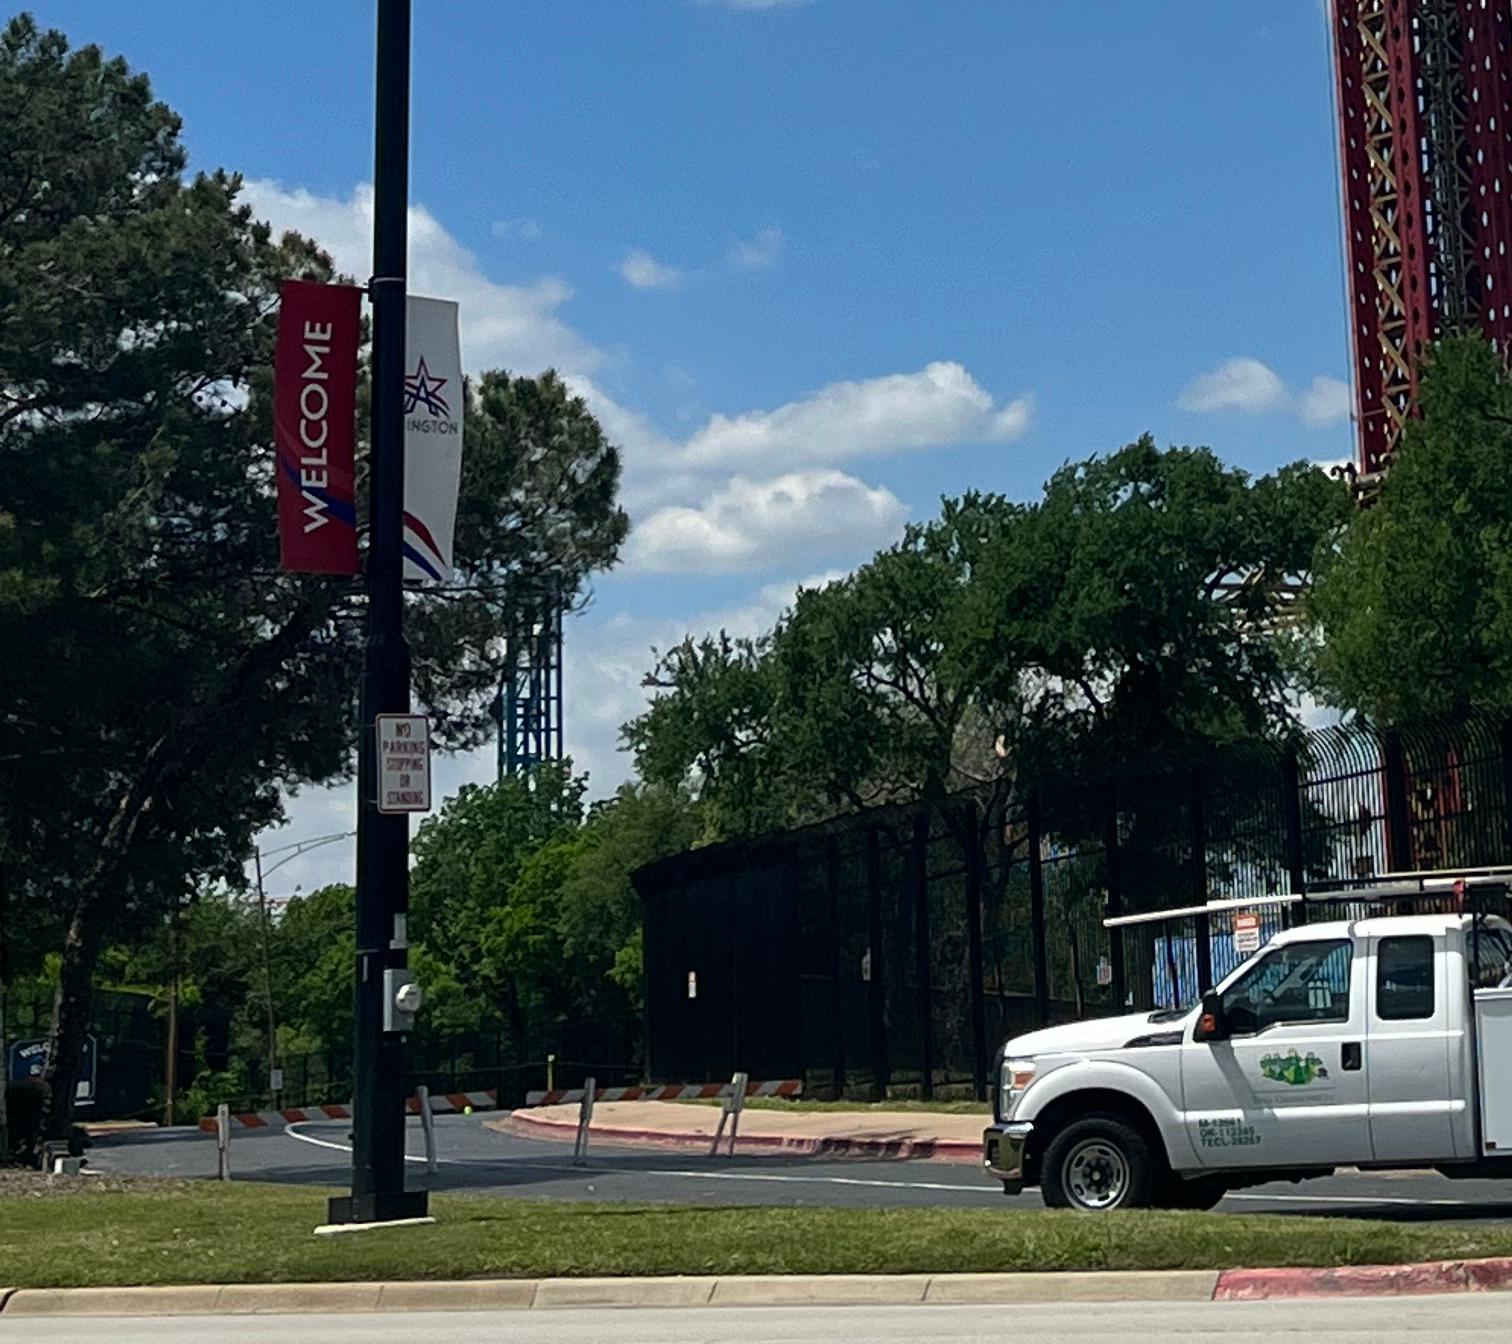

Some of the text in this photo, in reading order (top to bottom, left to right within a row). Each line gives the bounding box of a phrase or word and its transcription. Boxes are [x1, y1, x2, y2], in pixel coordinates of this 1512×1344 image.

[300, 319, 332, 534] WELCOME
[406, 418, 459, 434] INGTON
[395, 722, 412, 738] NO
[383, 740, 425, 755] PARKING
[386, 757, 423, 771] STOPPING
[399, 773, 411, 788] OR
[386, 790, 424, 806] STANDING
